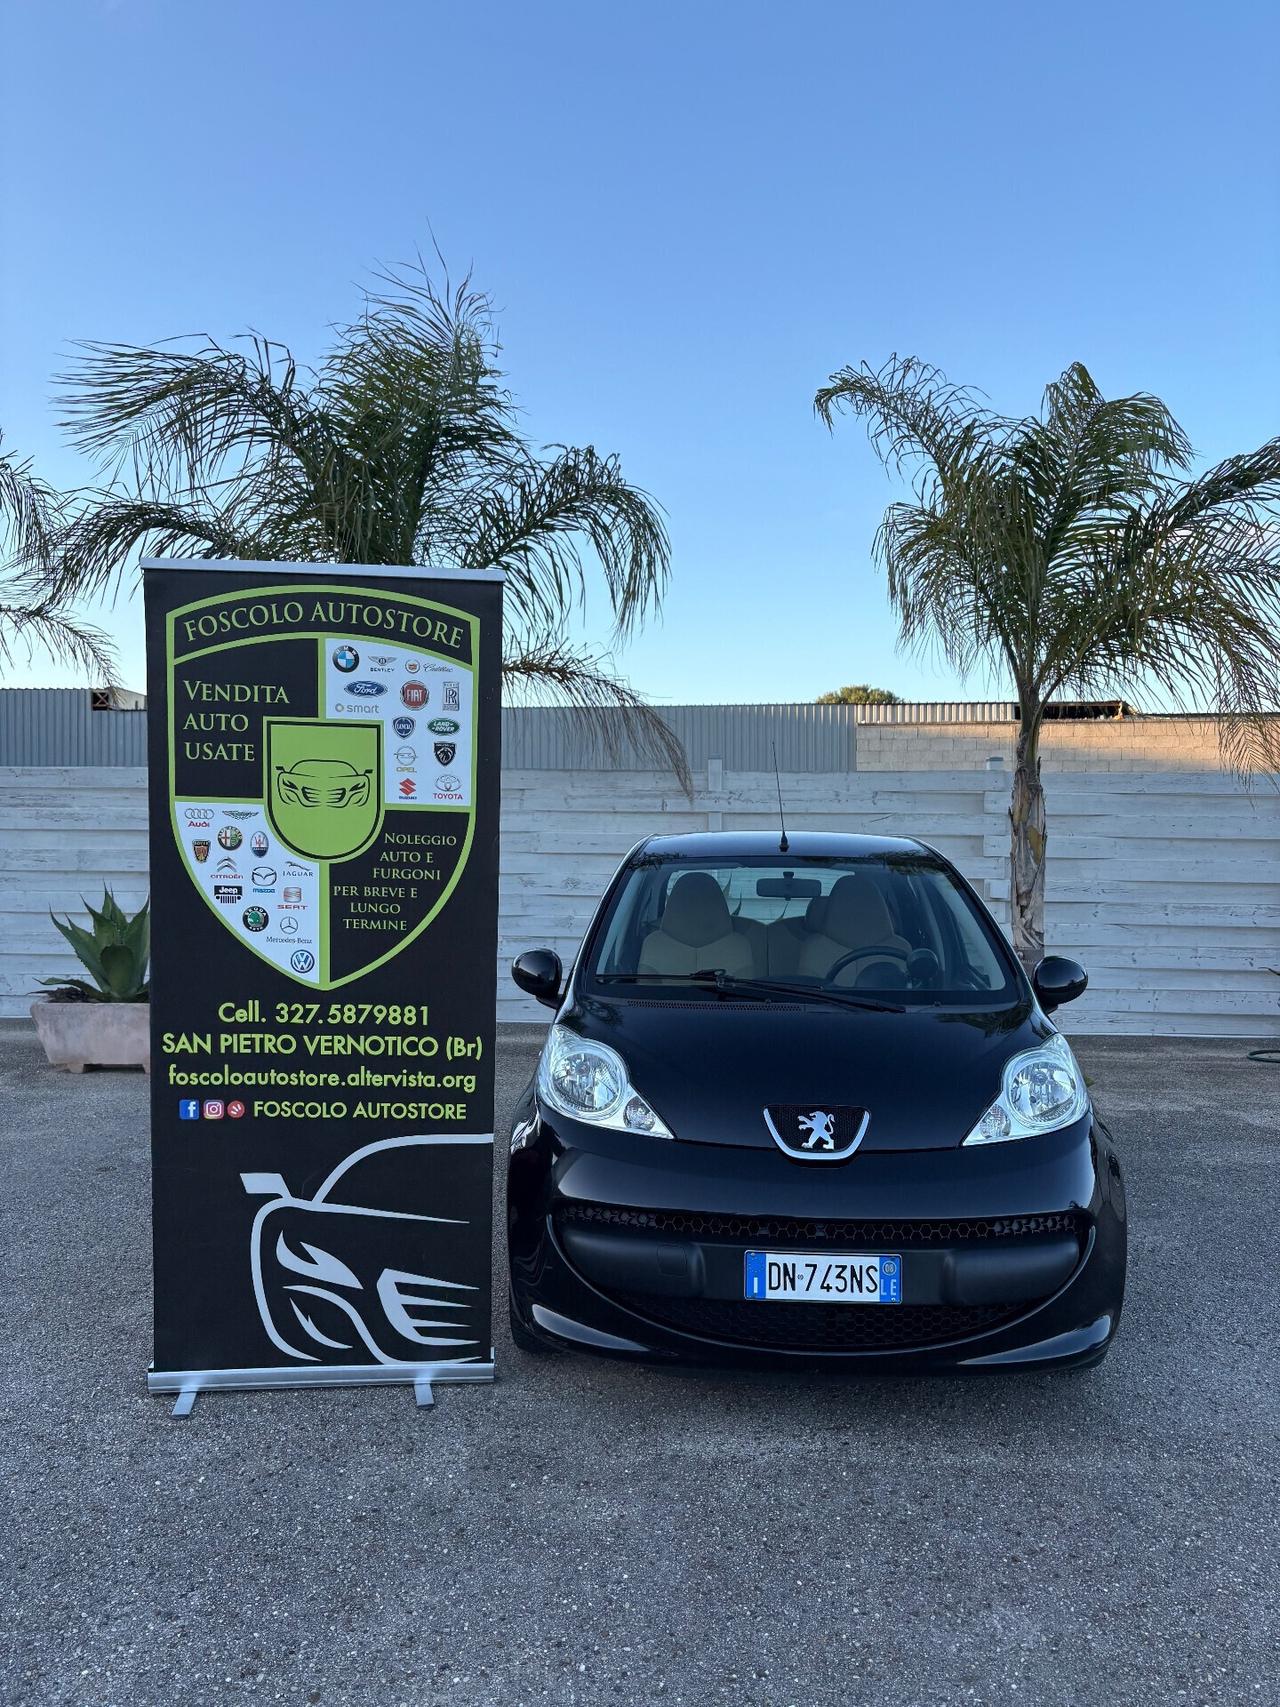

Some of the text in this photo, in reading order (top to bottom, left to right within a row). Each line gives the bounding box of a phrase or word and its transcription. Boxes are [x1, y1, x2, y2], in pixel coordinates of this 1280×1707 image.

[184, 601, 464, 648] FOSCOLO AUTOSTORE
[183, 680, 290, 704] VENDITA
[353, 681, 378, 695] Ford
[406, 689, 424, 702] FIAT
[346, 704, 380, 714] smart
[183, 713, 249, 732] AUTO
[184, 742, 255, 762] USATE
[384, 832, 457, 846] NOLEGGIO
[380, 851, 434, 863] AUTO E
[373, 868, 440, 880] FURGONI
[219, 886, 238, 895] Jeep
[333, 886, 418, 898] PER BREVE E
[350, 902, 401, 914] LUNGO
[343, 918, 407, 931] TERMINE
[218, 1000, 429, 1026] Cell. 327.5879881
[162, 1033, 483, 1061] SAN PIETRO VERNOTICO (Br)
[168, 1063, 477, 1094] foscoloautostore.altervista.org
[254, 1100, 347, 1119] FOSCOLO
[353, 1101, 467, 1120] AUTOSTORE
